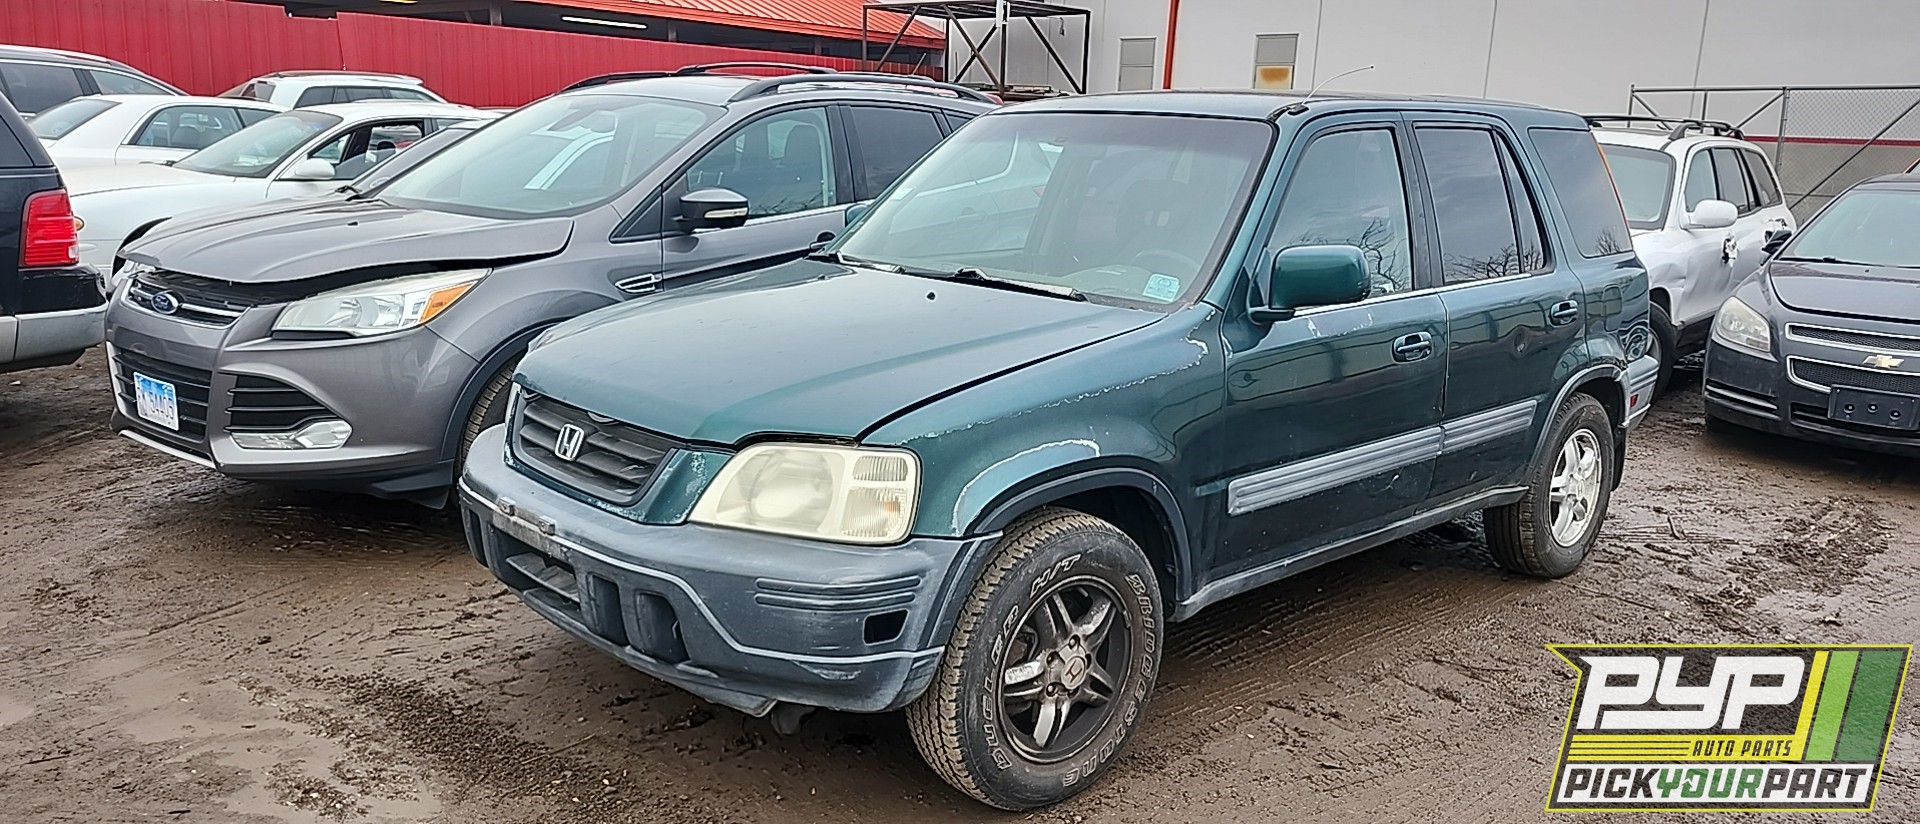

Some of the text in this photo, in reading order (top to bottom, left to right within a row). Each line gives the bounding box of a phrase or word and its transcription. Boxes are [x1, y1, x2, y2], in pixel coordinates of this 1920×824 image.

[983, 554, 1081, 770] DUELER H/T
[1063, 574, 1155, 787] BRIDGESTONE
